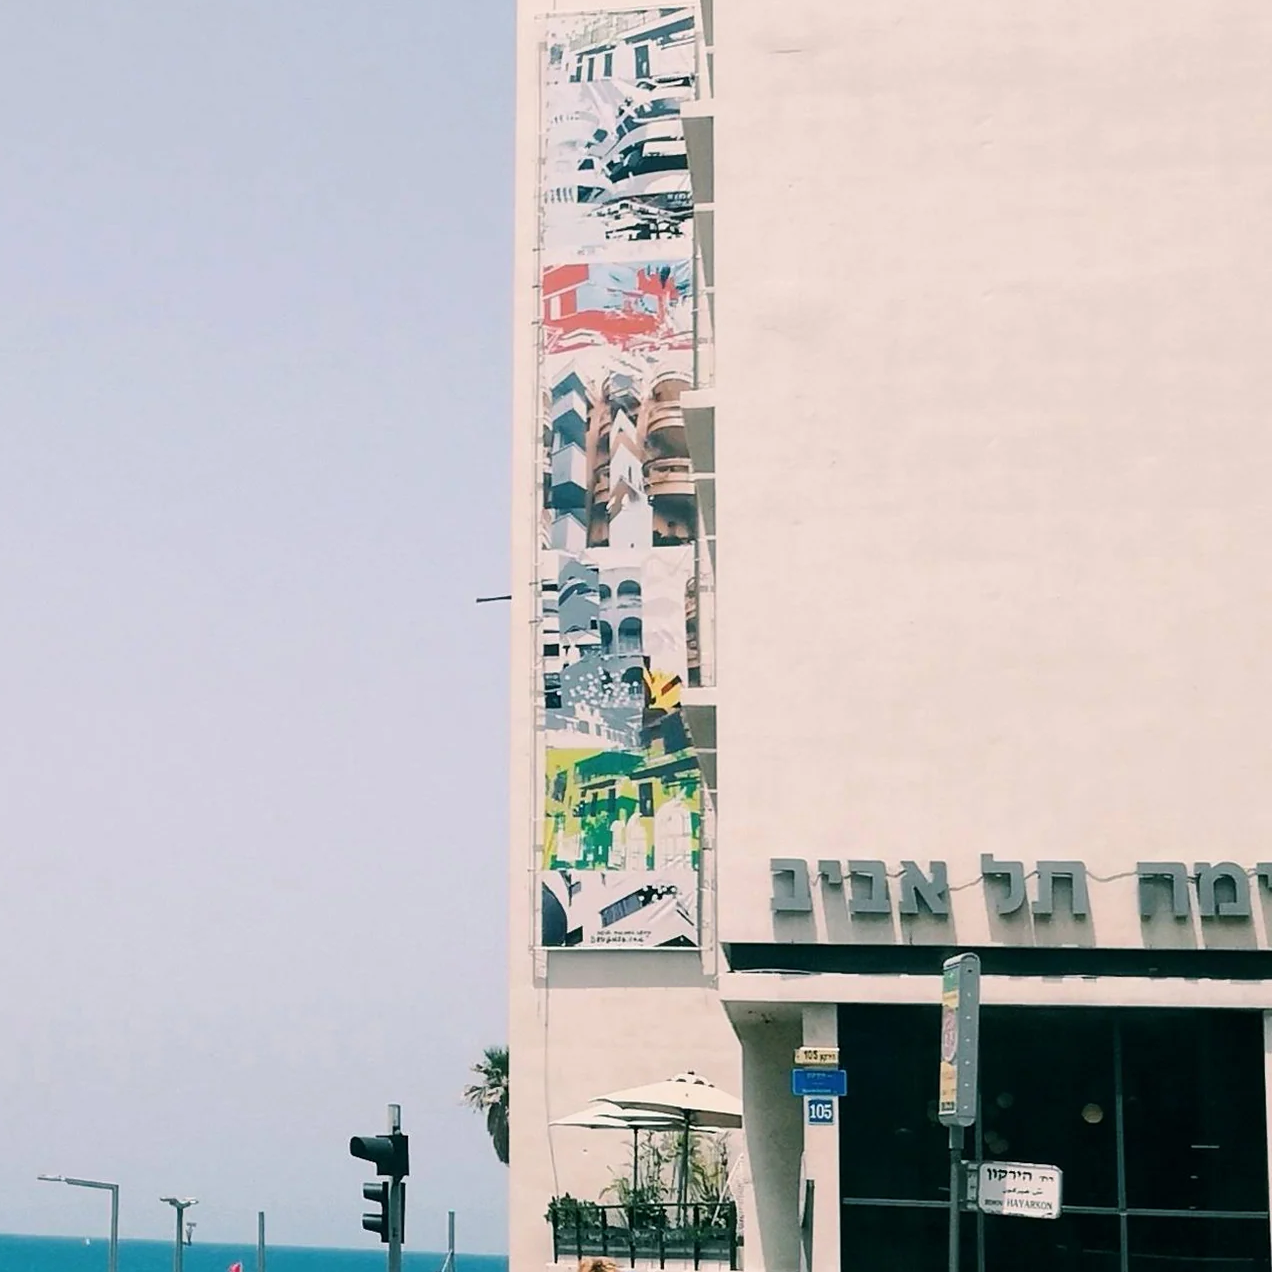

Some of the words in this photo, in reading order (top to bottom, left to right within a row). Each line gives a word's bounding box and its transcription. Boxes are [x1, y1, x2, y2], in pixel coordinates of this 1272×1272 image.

[771, 858, 949, 915] אביב
[981, 853, 1086, 917] תל
[809, 1104, 832, 1119] 105
[987, 1168, 1033, 1181] הירקון
[1007, 1198, 1053, 1210] HAYARKON
